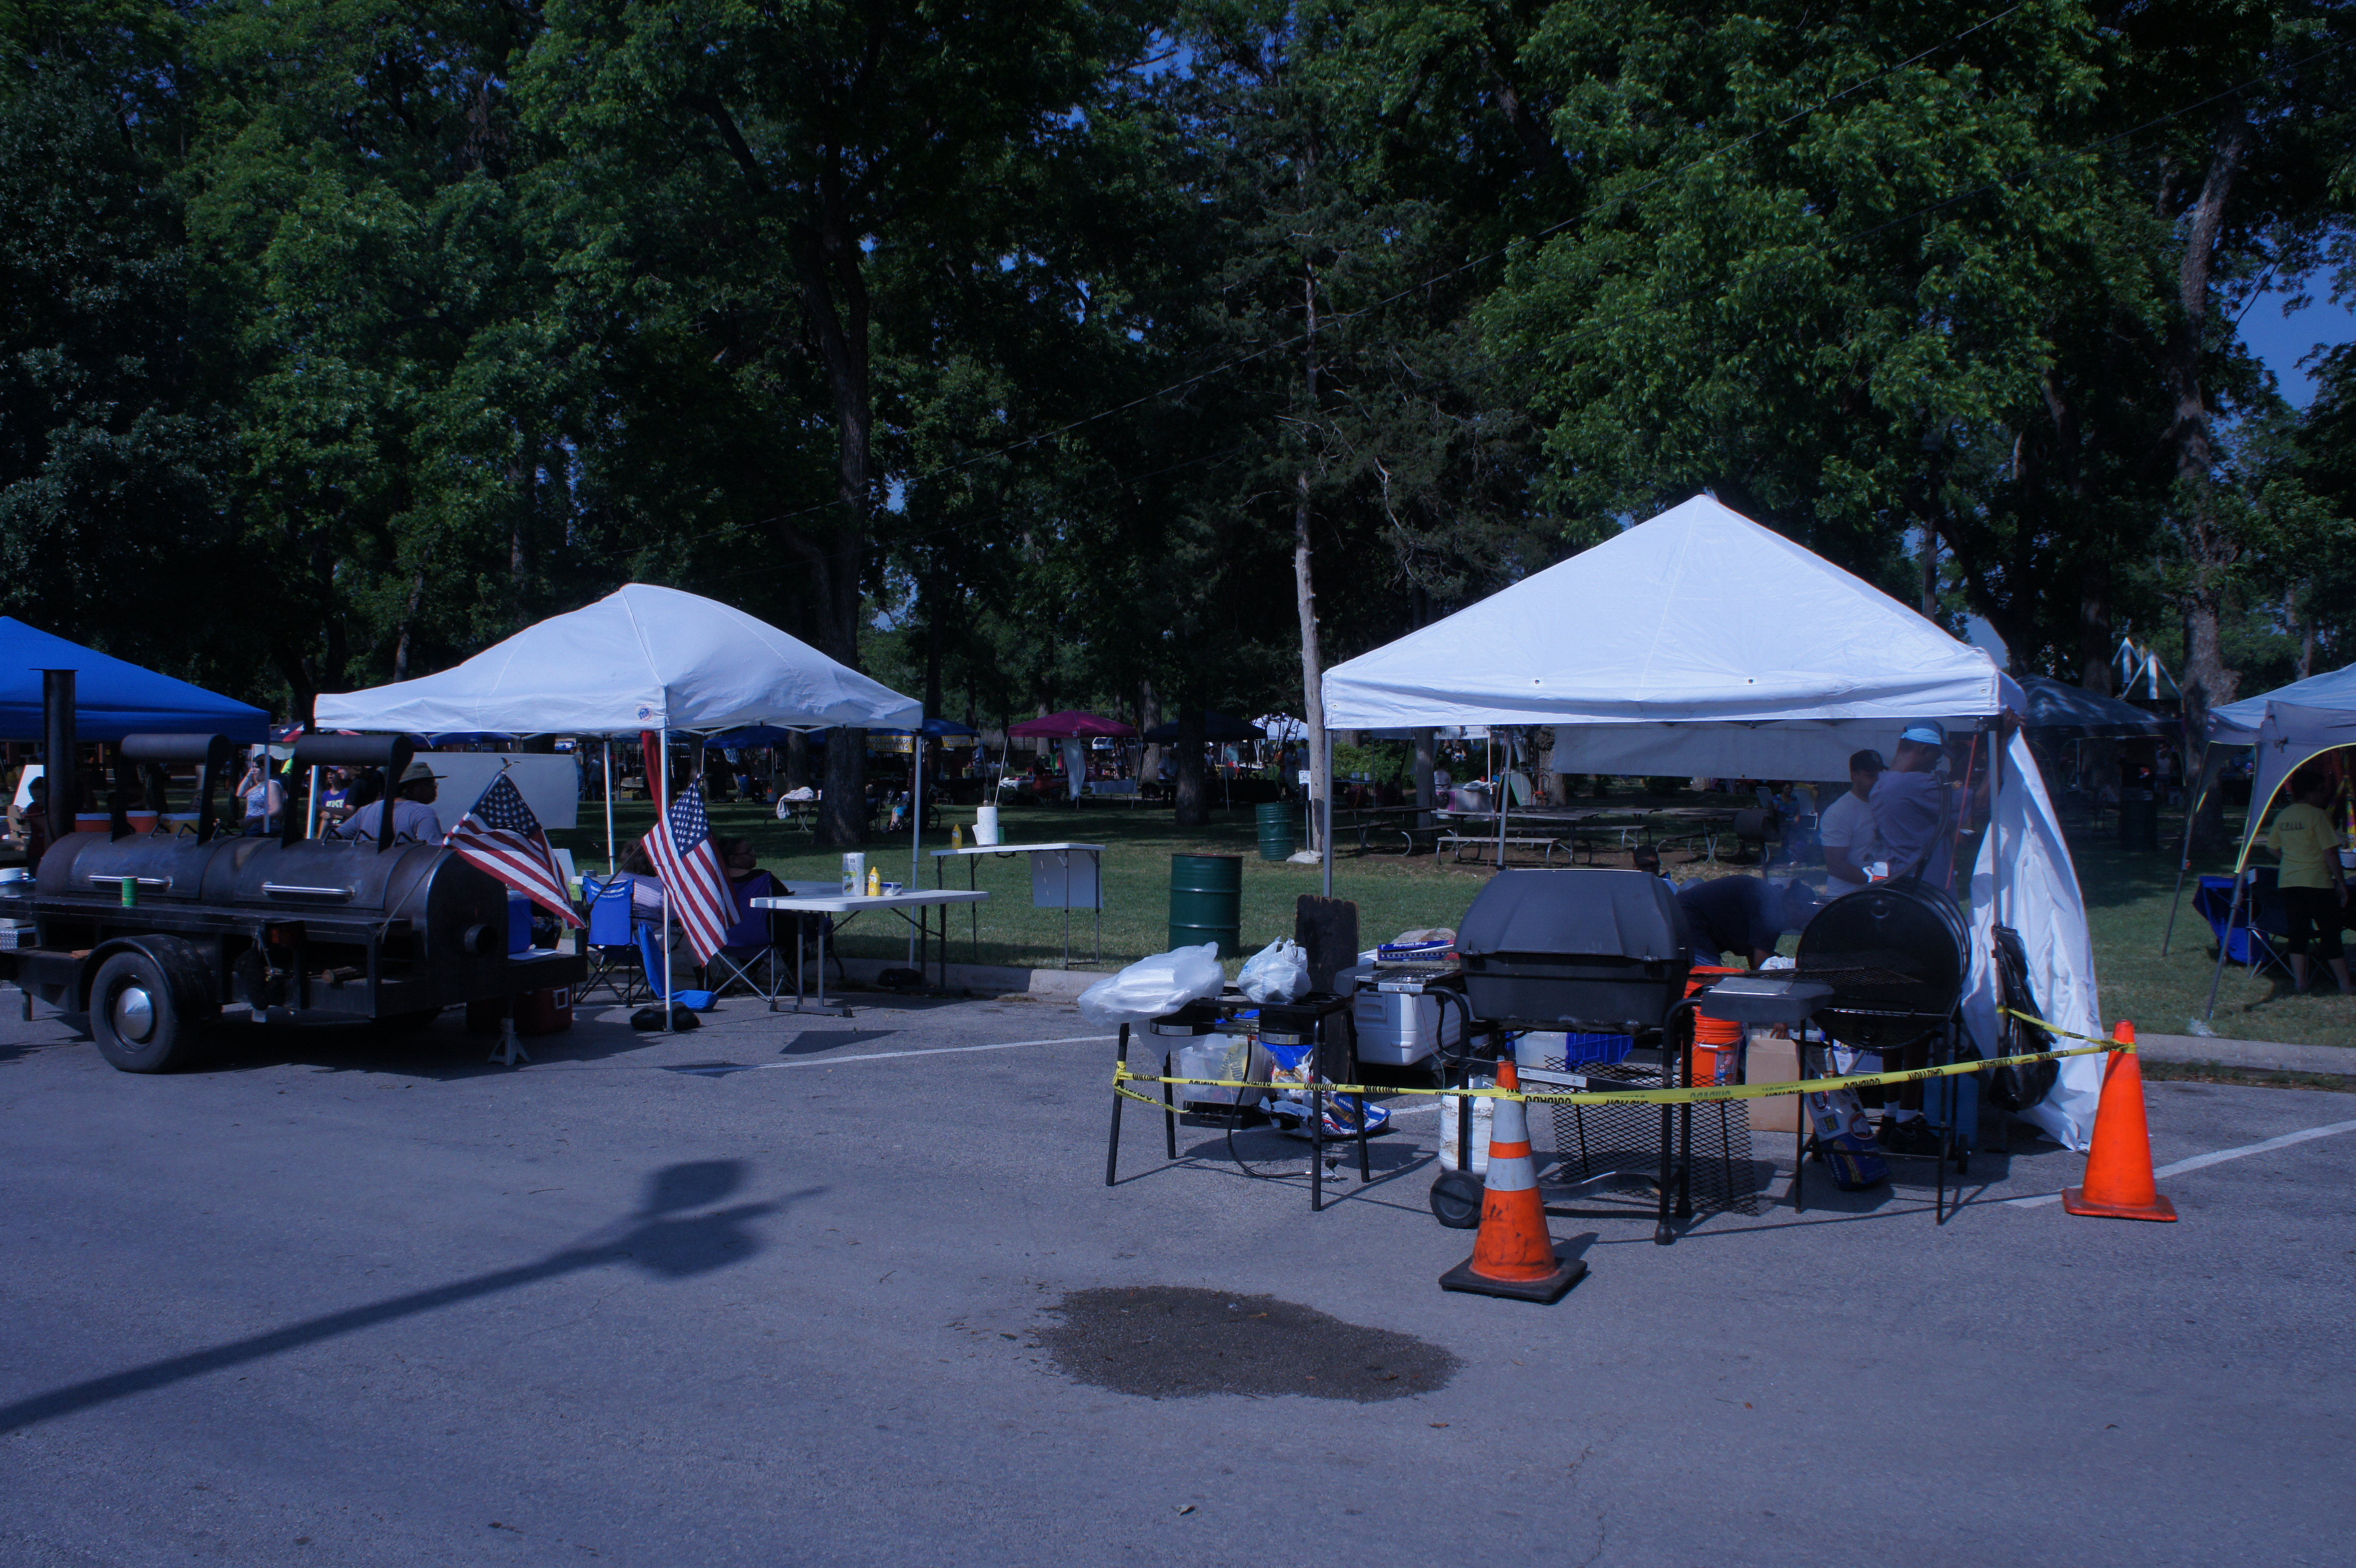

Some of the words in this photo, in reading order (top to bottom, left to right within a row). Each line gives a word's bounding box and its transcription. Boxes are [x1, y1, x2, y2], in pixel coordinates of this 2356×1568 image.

[1908, 1068, 1945, 1081] CAUTION
[1843, 1078, 1881, 1089] CUIDADO
[1338, 1097, 1355, 1112] RIGINAL
[1525, 1095, 1572, 1104] CUIDADO
